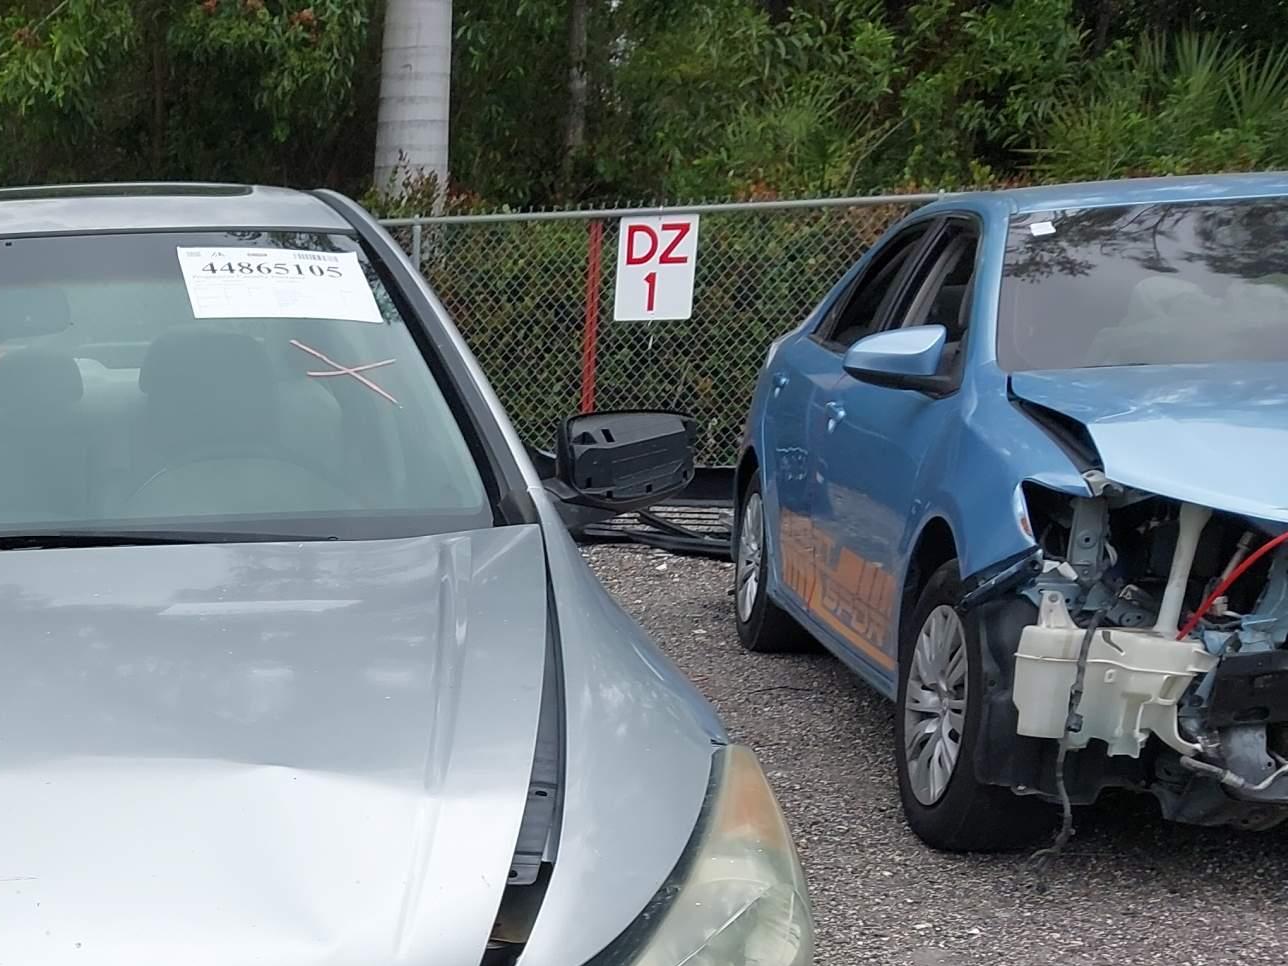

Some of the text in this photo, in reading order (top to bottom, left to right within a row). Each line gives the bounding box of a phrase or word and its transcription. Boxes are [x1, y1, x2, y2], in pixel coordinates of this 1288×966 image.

[626, 222, 691, 265] DZ
[201, 261, 343, 280] 44865105
[644, 271, 657, 311] 1
